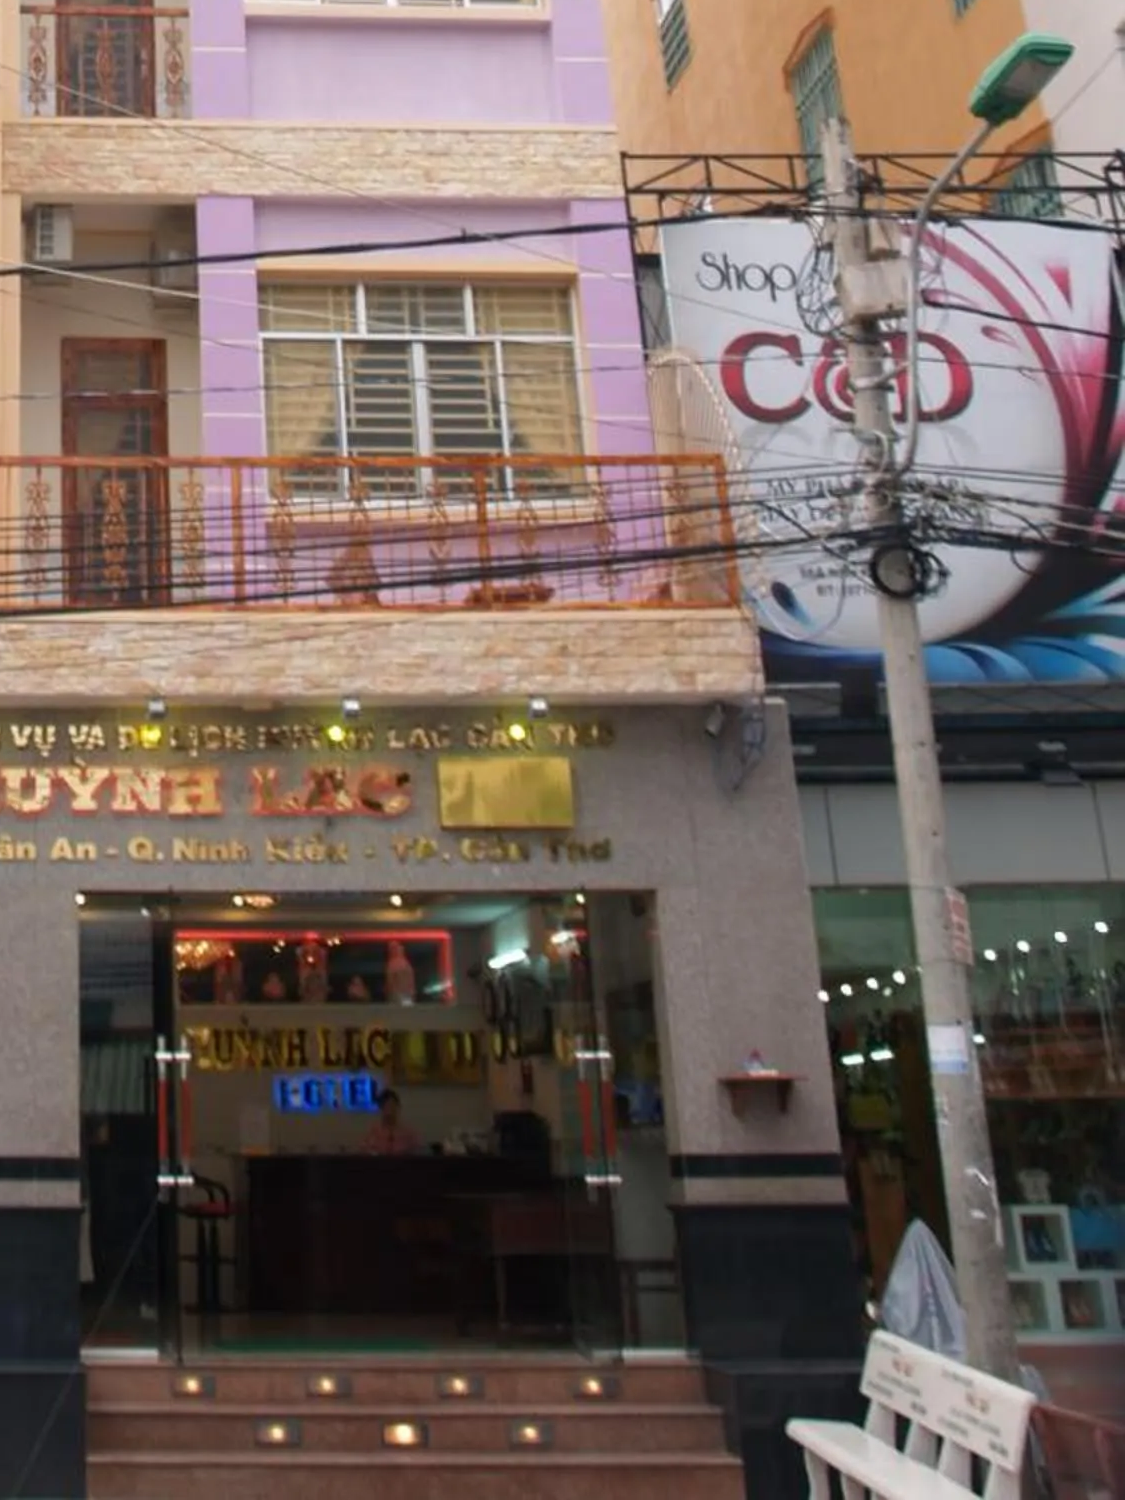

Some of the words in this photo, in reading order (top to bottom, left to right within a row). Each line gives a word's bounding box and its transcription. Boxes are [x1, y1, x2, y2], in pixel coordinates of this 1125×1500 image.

[696, 252, 796, 302] Shop
[11, 723, 58, 758] VỤ
[50, 838, 98, 861] An
[173, 838, 251, 862] Ninh
